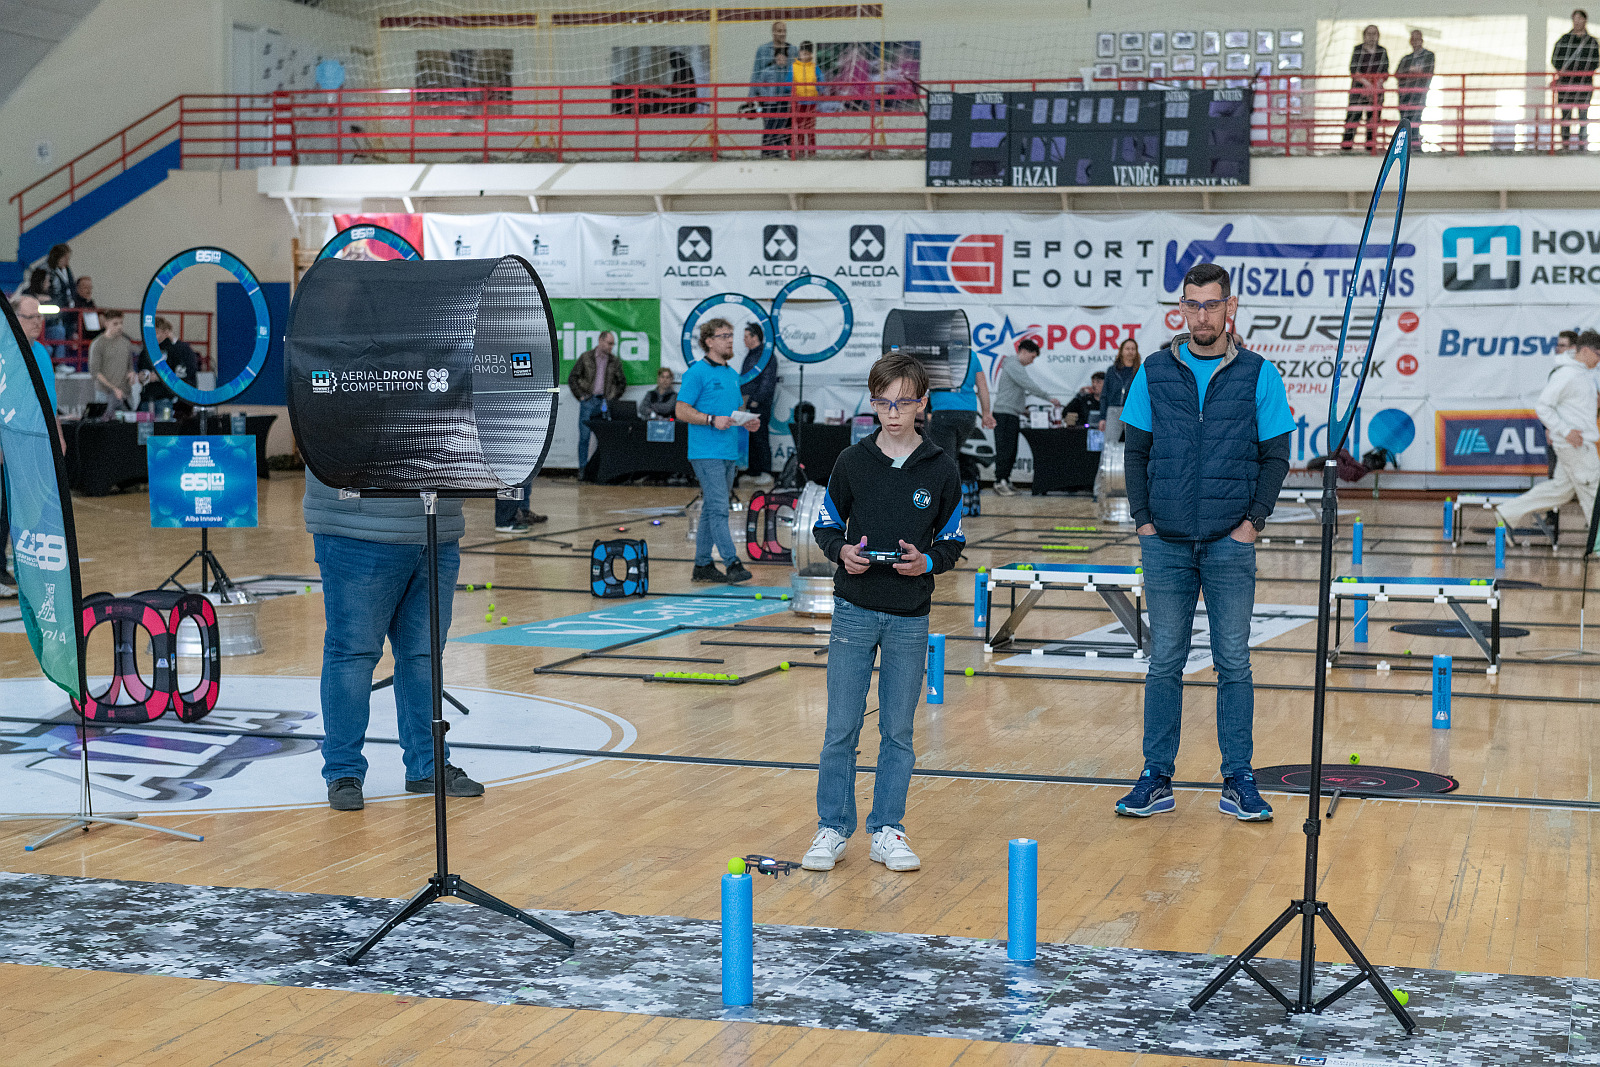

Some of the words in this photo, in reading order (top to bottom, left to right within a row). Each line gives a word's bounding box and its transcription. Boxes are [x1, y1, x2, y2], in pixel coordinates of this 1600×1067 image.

[1012, 166, 1058, 187] HAZAI
[1113, 162, 1159, 187] VENDÉG
[1013, 239, 1154, 259] SPORT
[664, 265, 727, 277] ALCOA
[749, 265, 812, 277] ALCOA
[835, 265, 899, 277] ALCOA
[1012, 268, 1154, 288] COURT
[1047, 354, 1076, 363] SPORT
[1088, 355, 1115, 364] MARK
[341, 381, 424, 392] COMPETITION
[1495, 427, 1549, 456] AL
[913, 493, 931, 504] RUN
